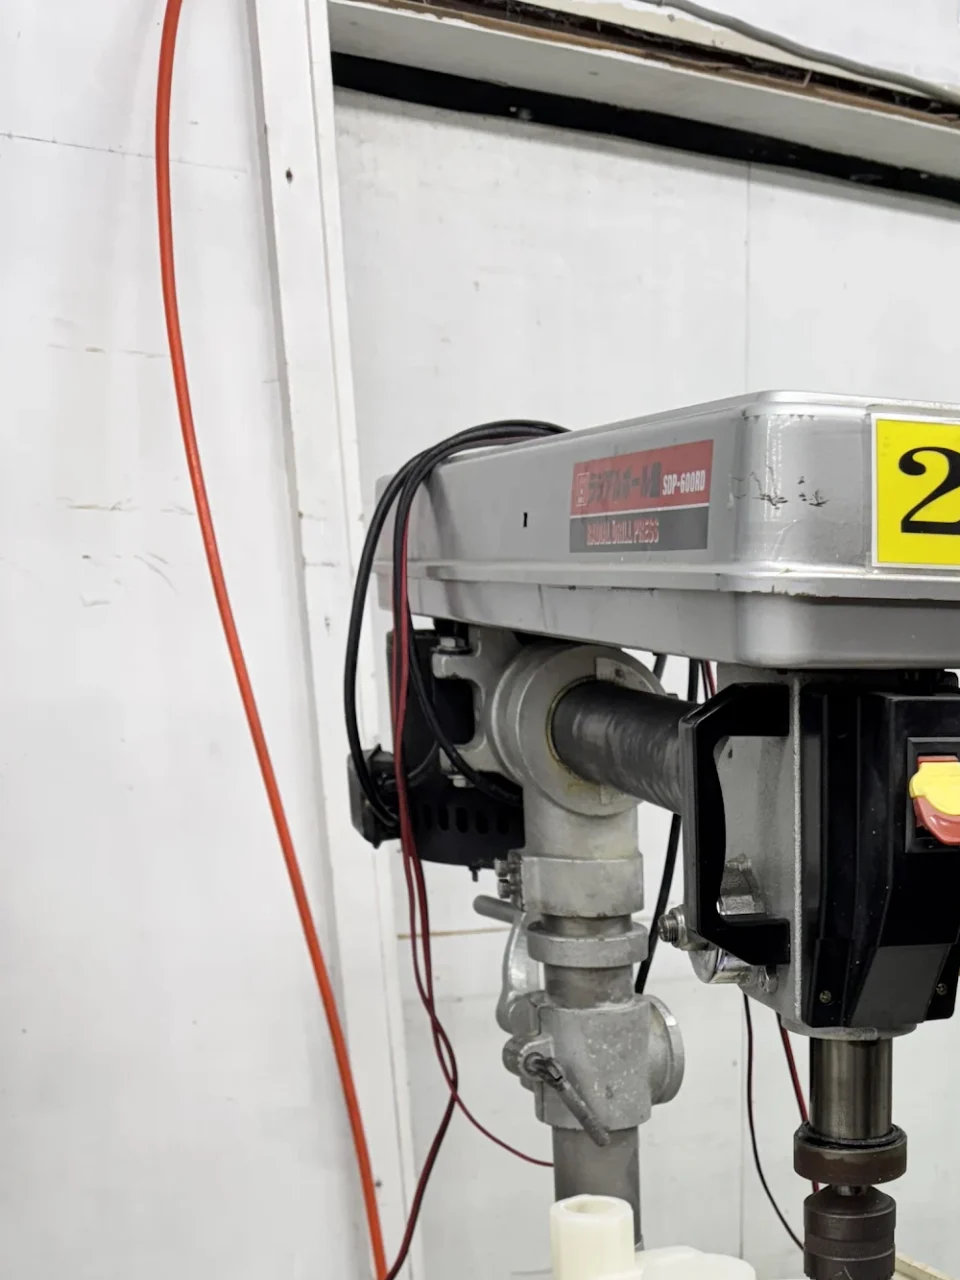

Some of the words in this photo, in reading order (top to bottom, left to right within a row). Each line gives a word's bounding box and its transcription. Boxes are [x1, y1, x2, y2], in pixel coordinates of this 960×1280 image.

[662, 470, 706, 496] SDP-600RD
[612, 519, 632, 544] DRILL
[633, 517, 659, 543] PRESS
